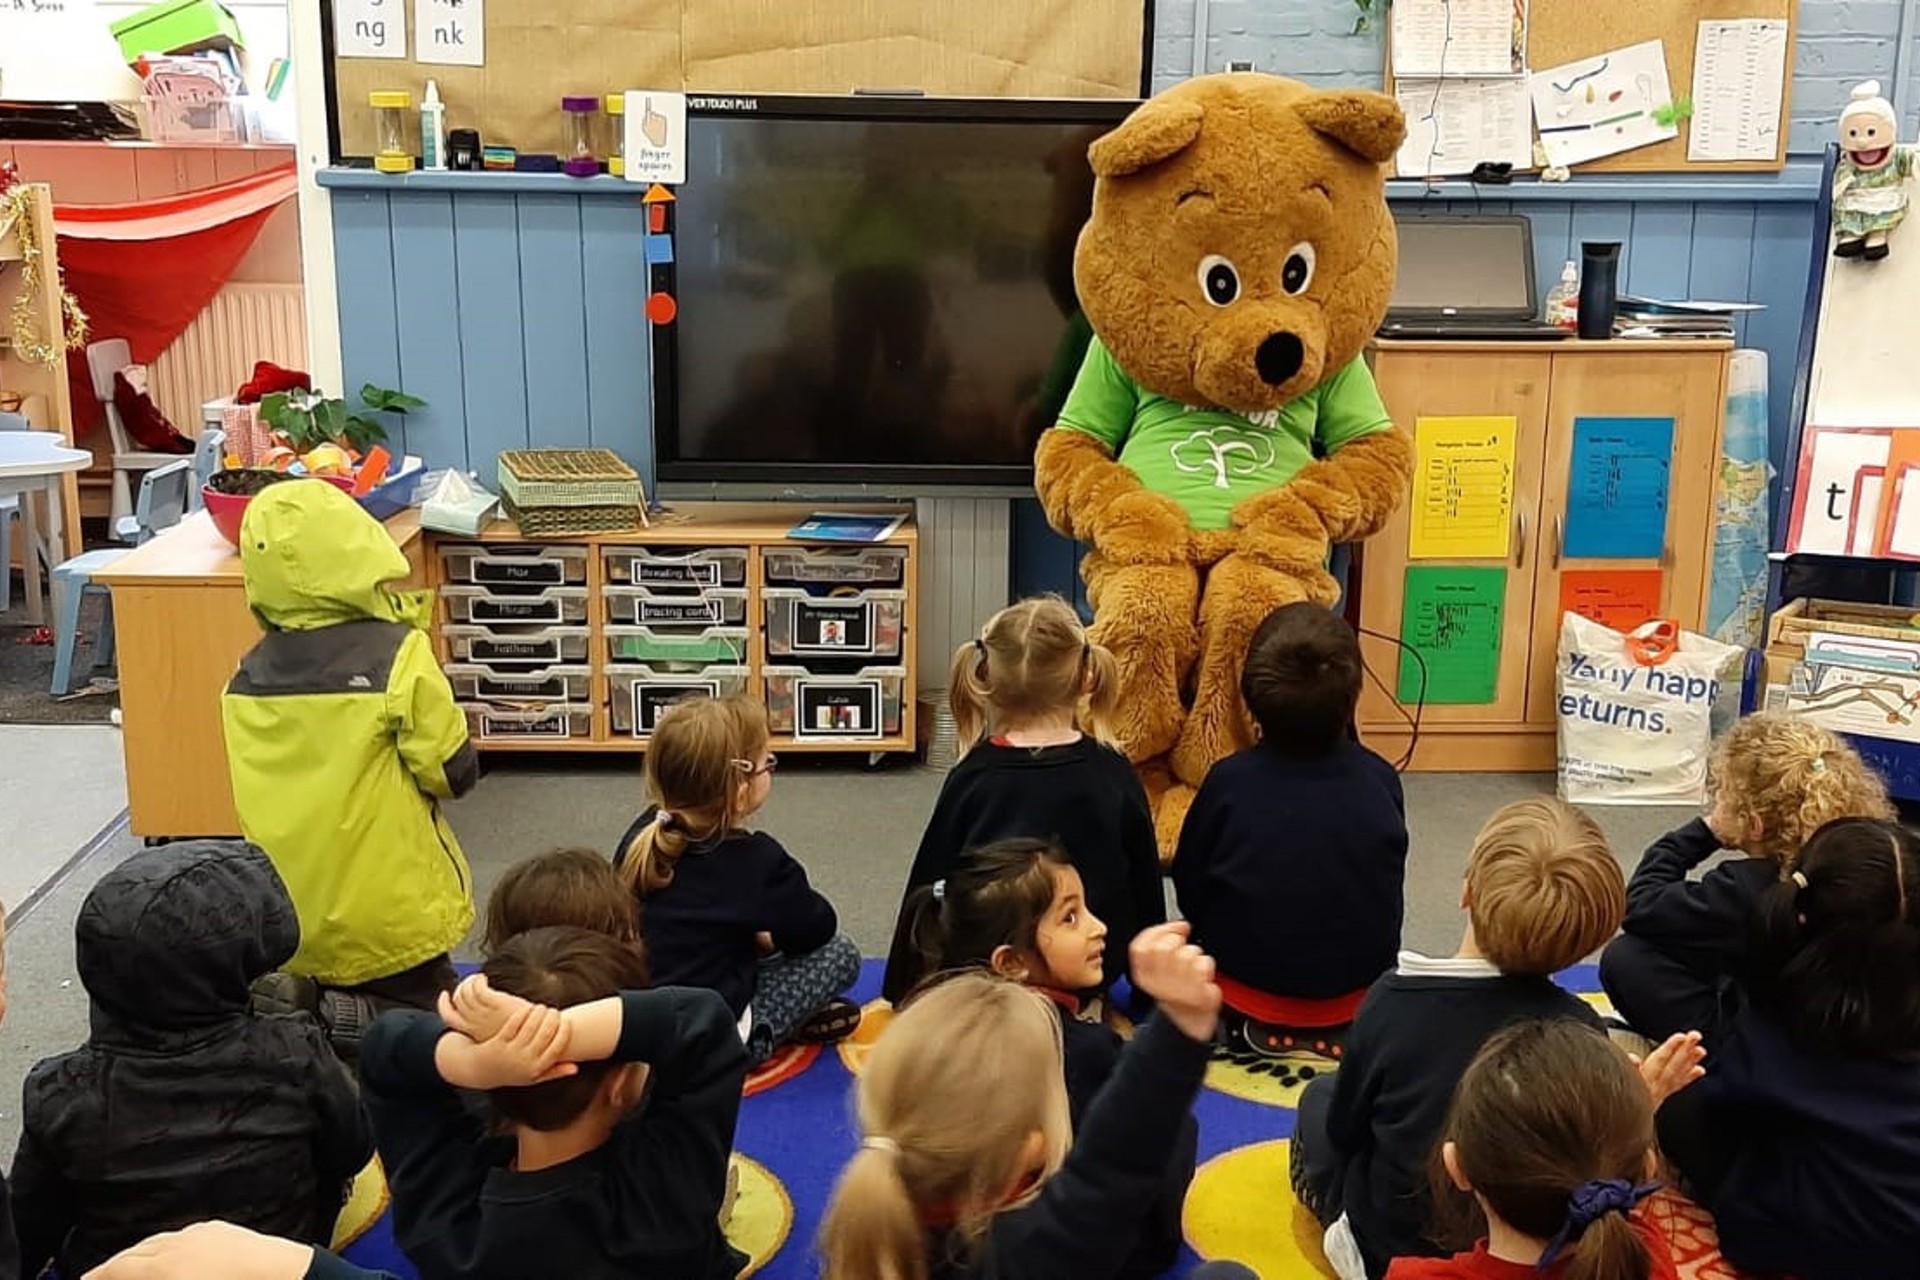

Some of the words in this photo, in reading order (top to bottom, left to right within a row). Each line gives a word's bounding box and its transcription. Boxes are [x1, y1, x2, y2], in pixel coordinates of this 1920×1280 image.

[355, 20, 386, 47] ng
[434, 20, 464, 45] nk
[735, 98, 758, 110] PLUS
[639, 148, 671, 161] finger
[638, 162, 673, 172] spaces
[1825, 481, 1846, 521] t
[645, 605, 683, 618] tracing
[1557, 692, 1673, 735] eturns.
